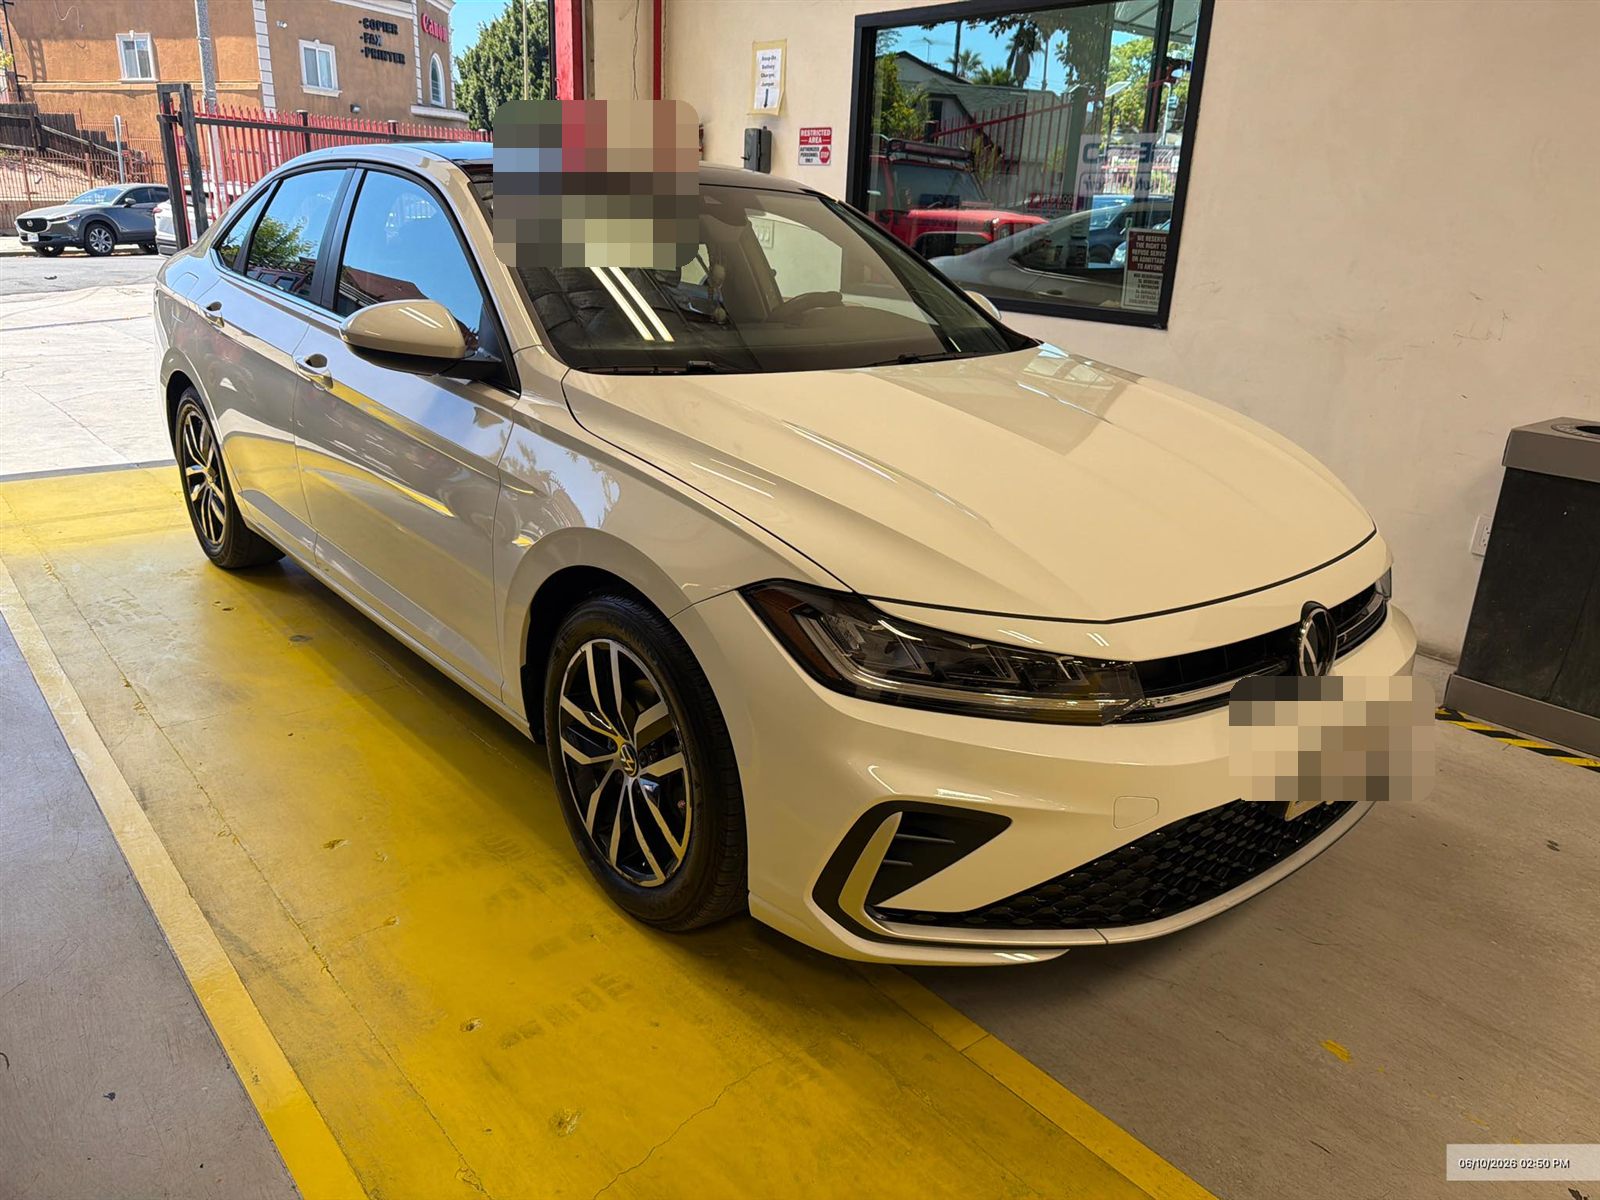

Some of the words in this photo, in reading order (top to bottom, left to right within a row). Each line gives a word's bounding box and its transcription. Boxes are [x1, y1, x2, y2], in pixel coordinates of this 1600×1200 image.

[362, 18, 398, 34] COPIER
[421, 13, 448, 42] Canon
[363, 32, 382, 46] FAX
[364, 47, 405, 65] PRINTER
